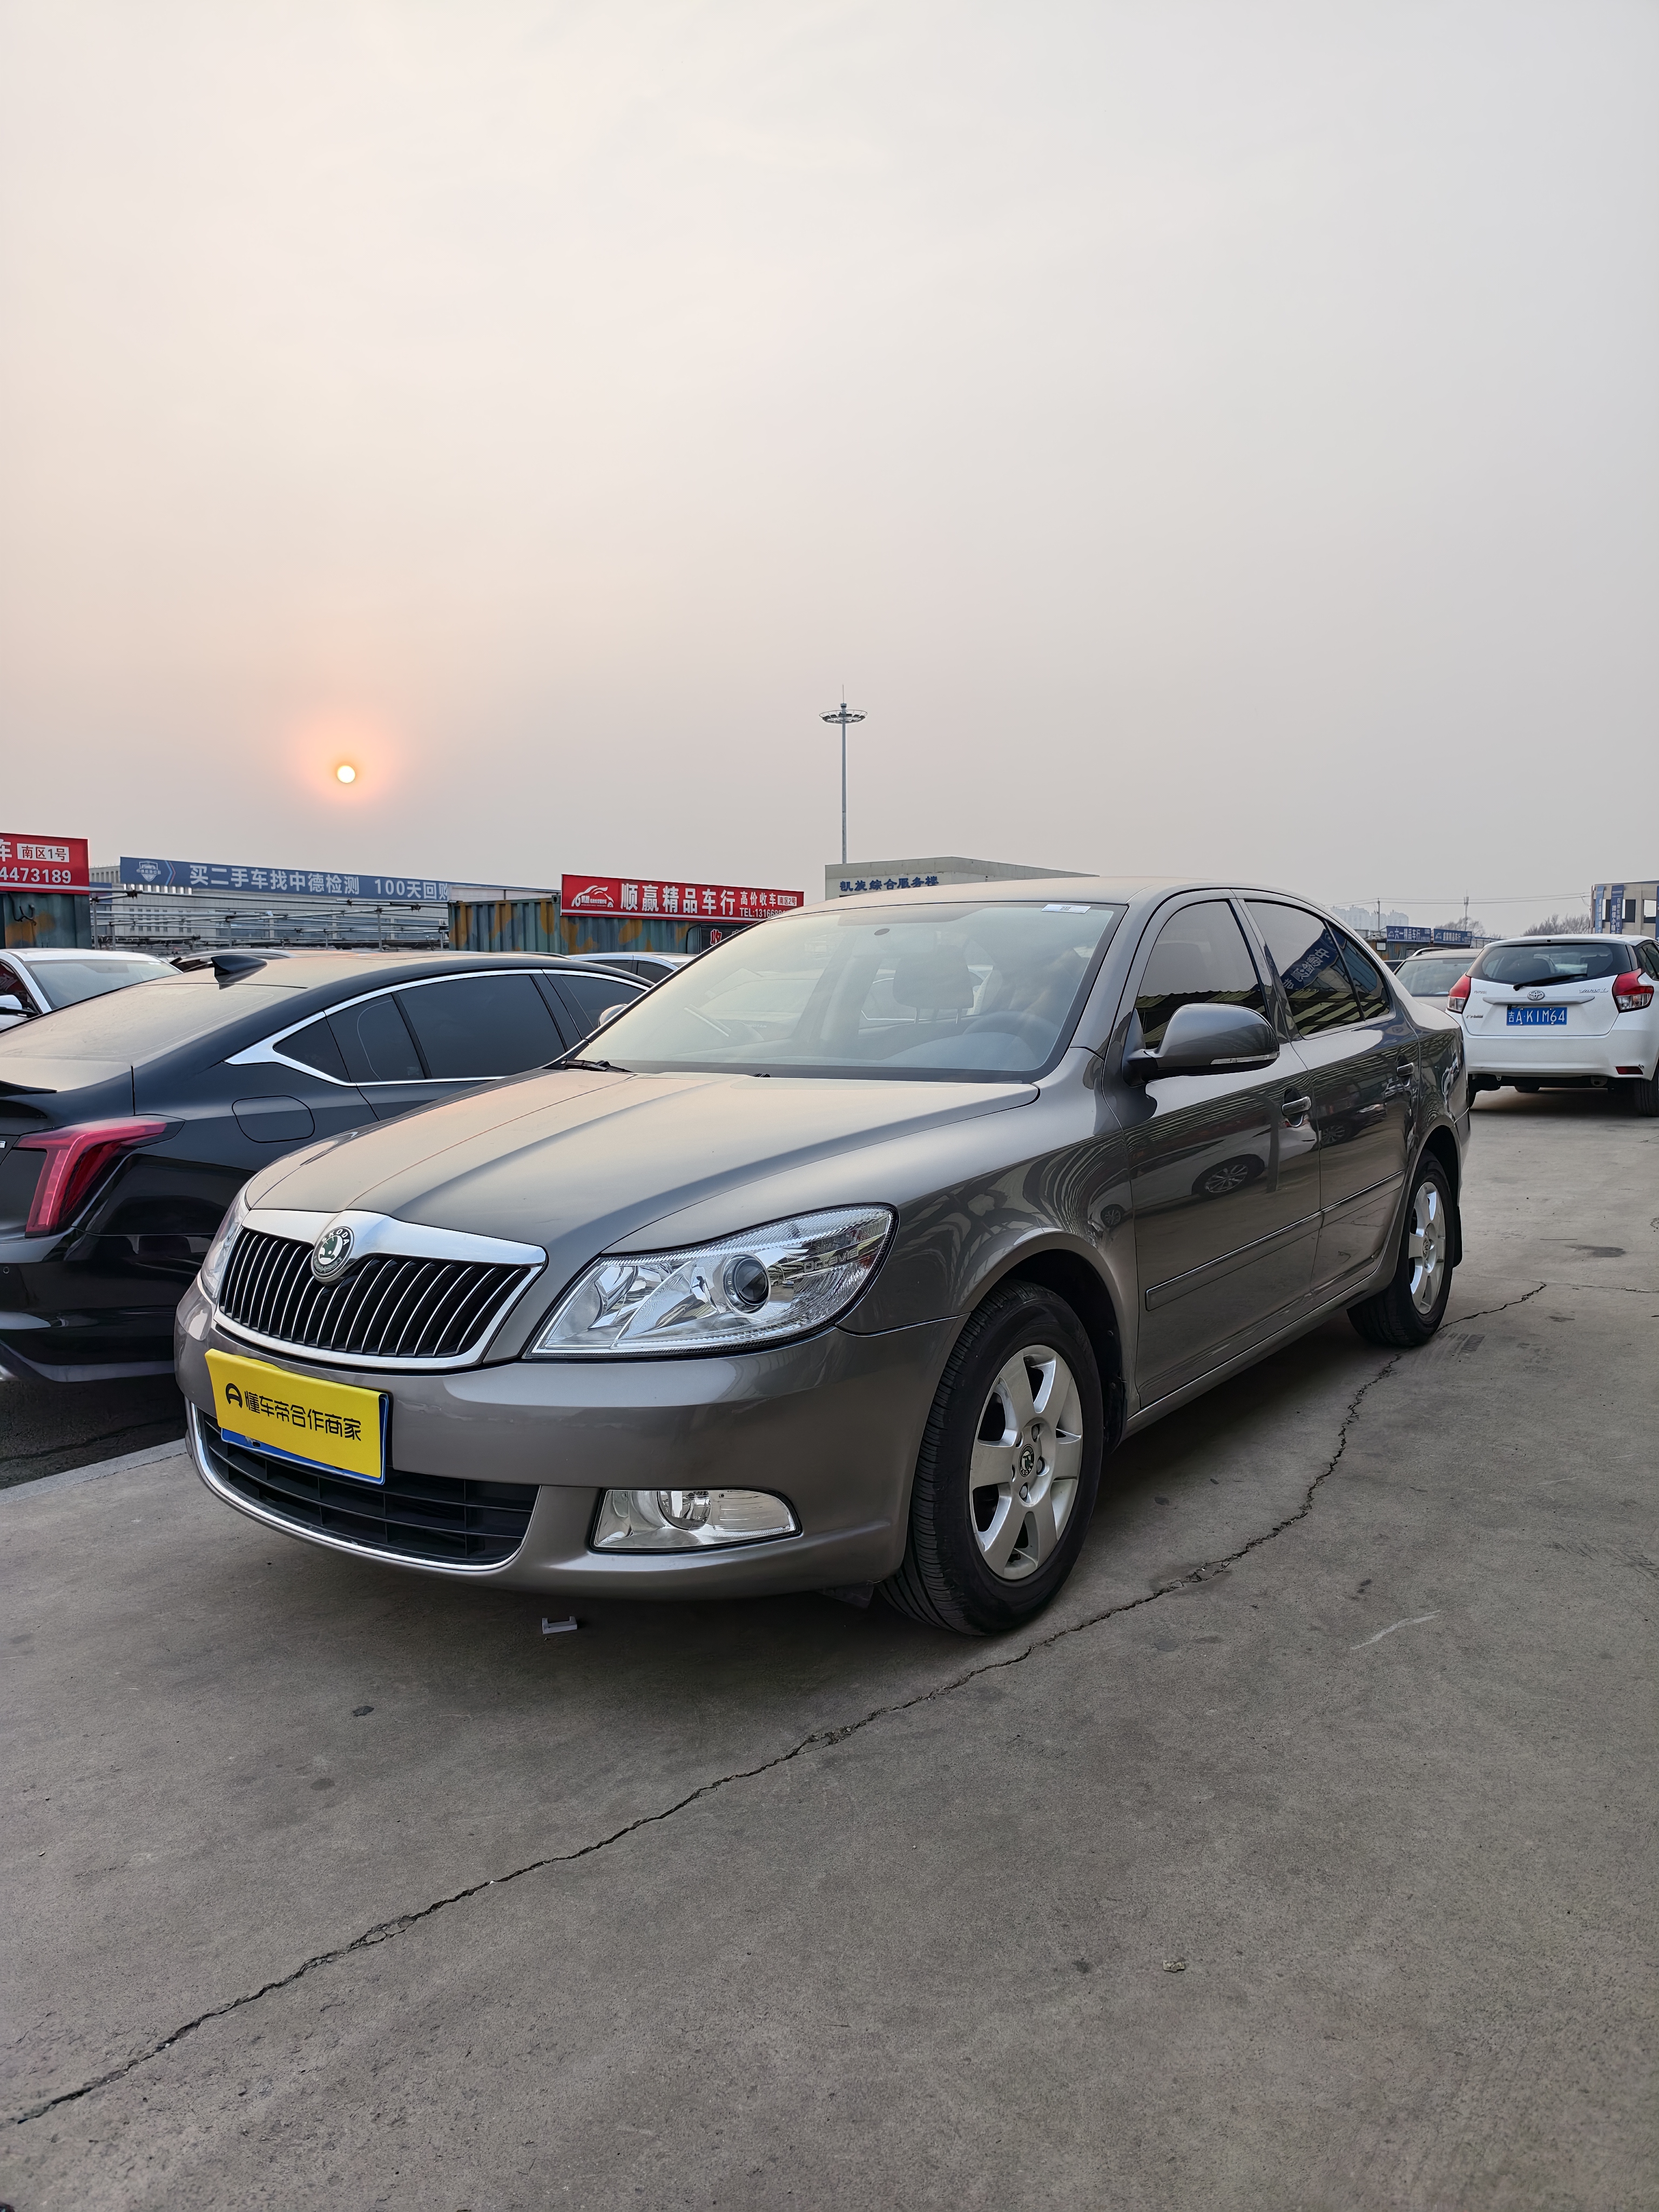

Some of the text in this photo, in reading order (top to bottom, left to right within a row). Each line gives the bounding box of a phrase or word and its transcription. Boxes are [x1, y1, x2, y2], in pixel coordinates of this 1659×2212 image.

[22, 845, 66, 861] 南区1号
[0, 867, 71, 884] 4473189
[190, 865, 359, 895] 买二手车找中德检测
[621, 884, 735, 915] 顺赢精品车行
[740, 891, 776, 907] 高价收车
[779, 896, 795, 905] 南区2号
[245, 1390, 361, 1441] 懂车帝合作商家
